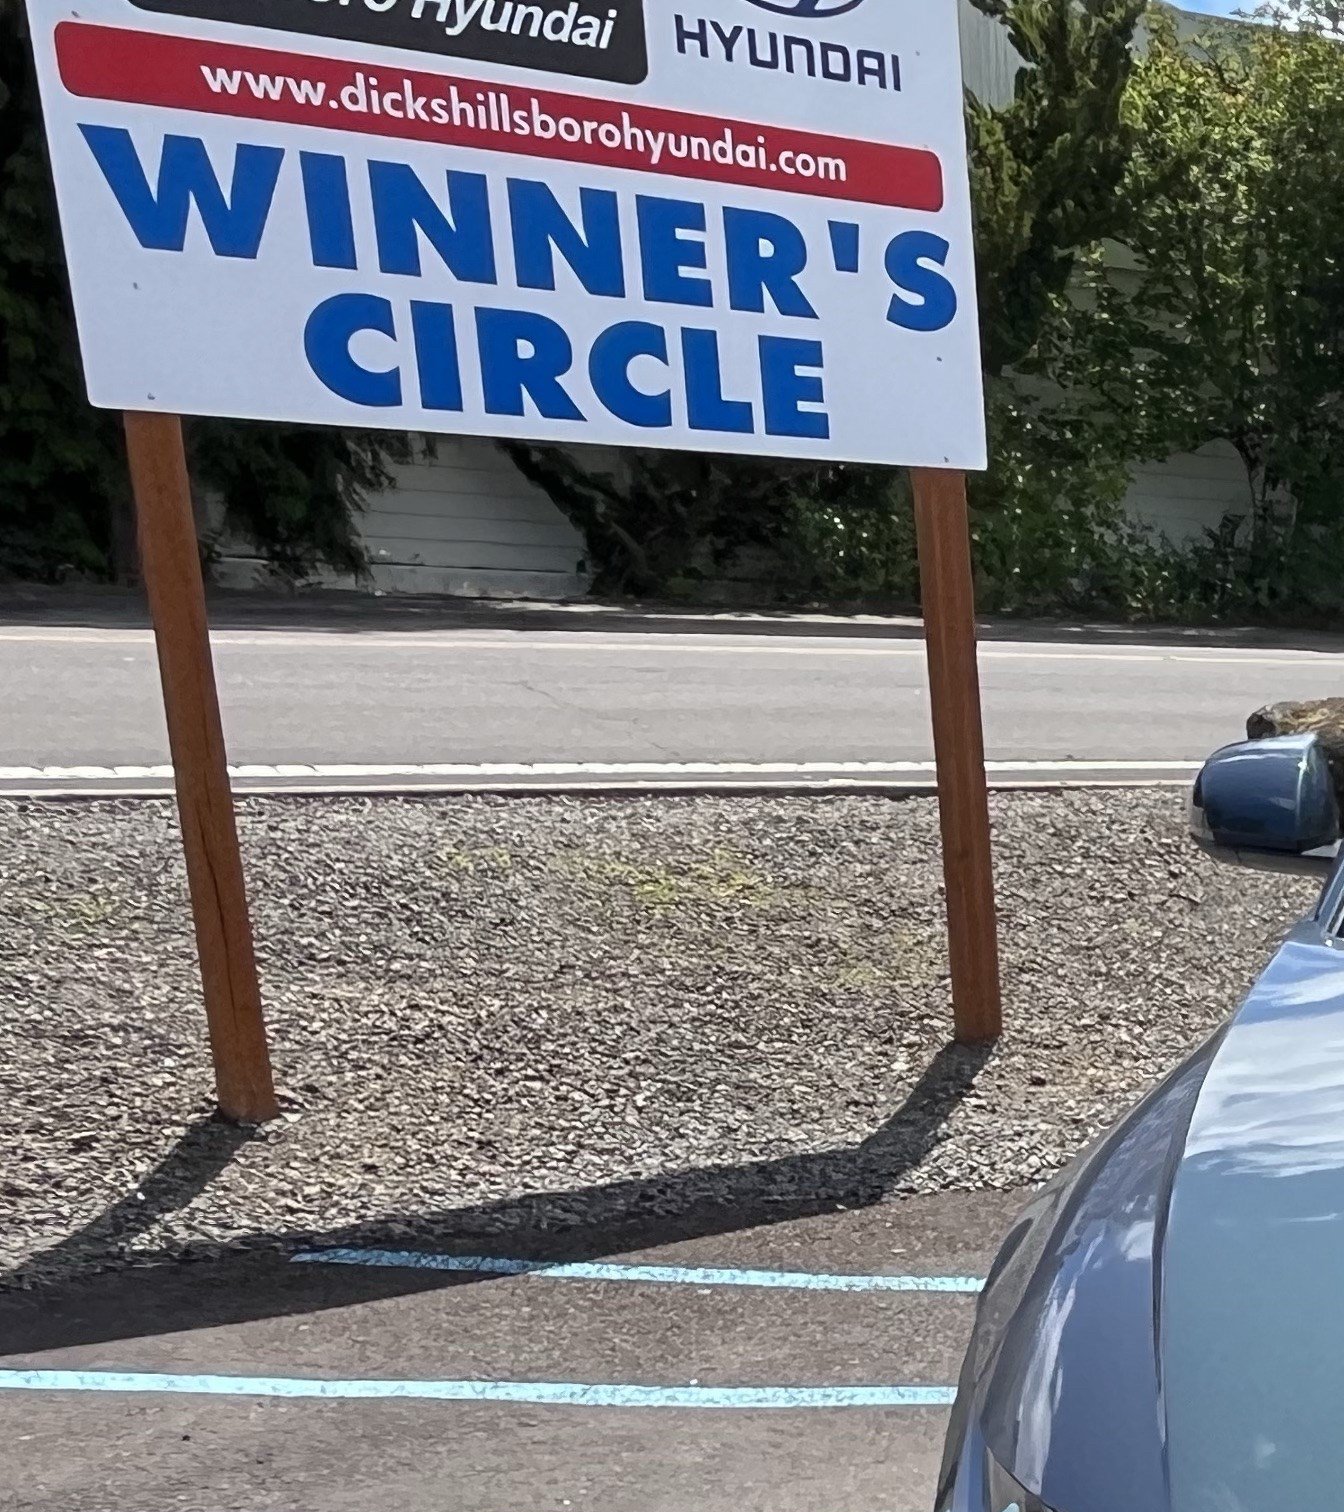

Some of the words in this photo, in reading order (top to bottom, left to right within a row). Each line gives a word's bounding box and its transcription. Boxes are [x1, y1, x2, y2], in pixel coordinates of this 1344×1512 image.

[411, 0, 618, 49] Hyundai
[674, 14, 902, 92] HYUNDAI
[200, 65, 848, 184] www.dickshillsborohyundai.com
[77, 123, 958, 333] WINNER'S
[303, 293, 831, 441] CIRCLE
